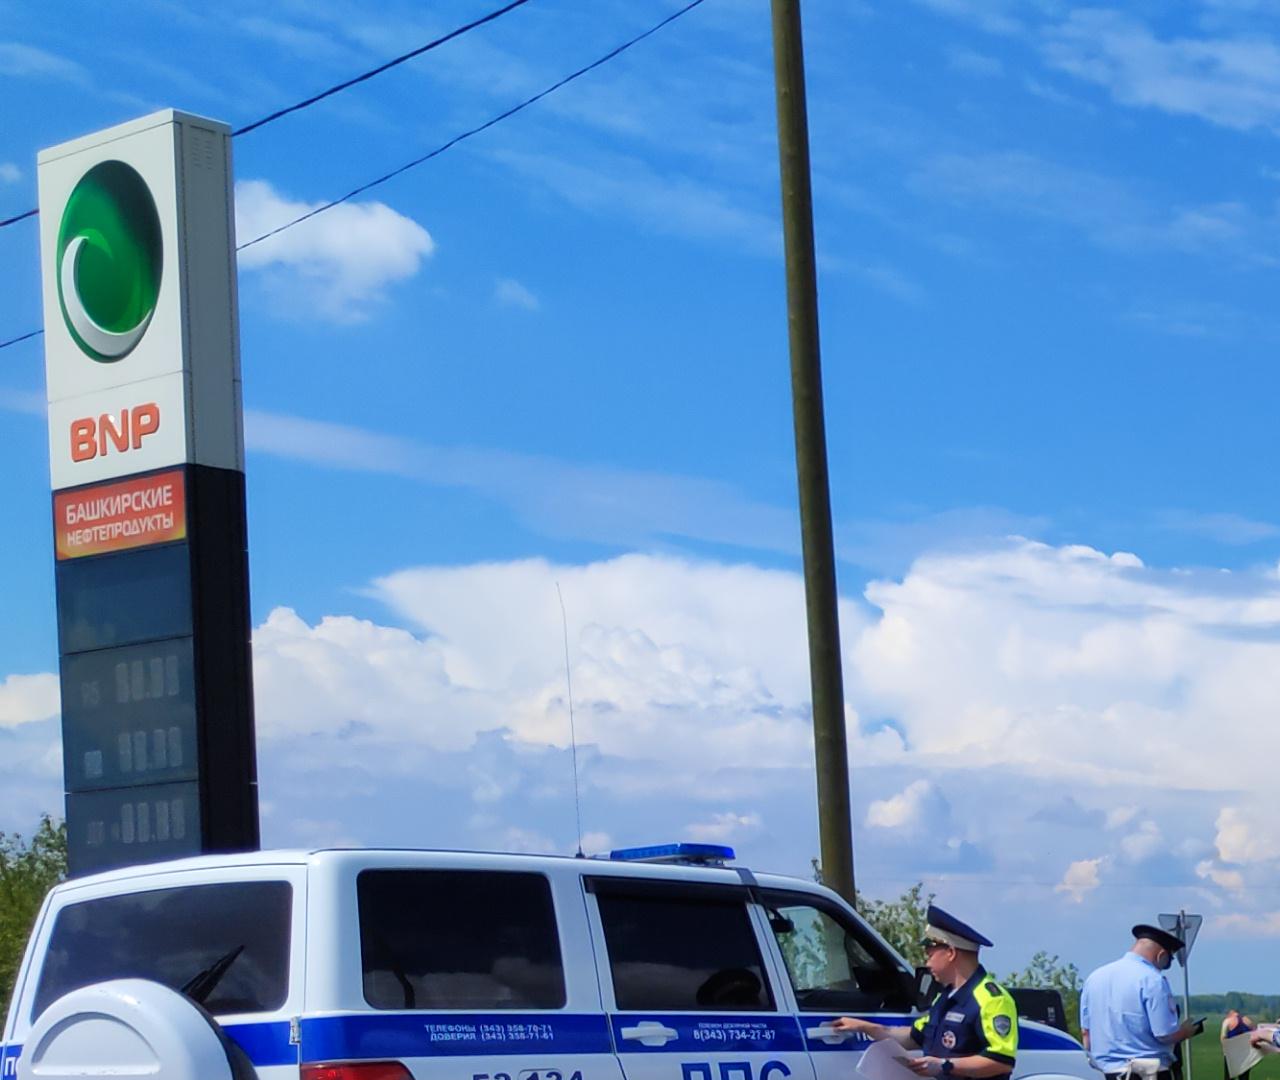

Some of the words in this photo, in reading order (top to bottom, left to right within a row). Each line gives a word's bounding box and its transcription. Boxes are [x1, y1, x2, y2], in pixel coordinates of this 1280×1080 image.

[70, 403, 160, 463] BNP
[66, 485, 172, 525] БАШКИРСКИЕ
[67, 512, 174, 547] НЕФТЕПРОДУКТЫ
[430, 1032, 477, 1041] ДОВЕРИЯ
